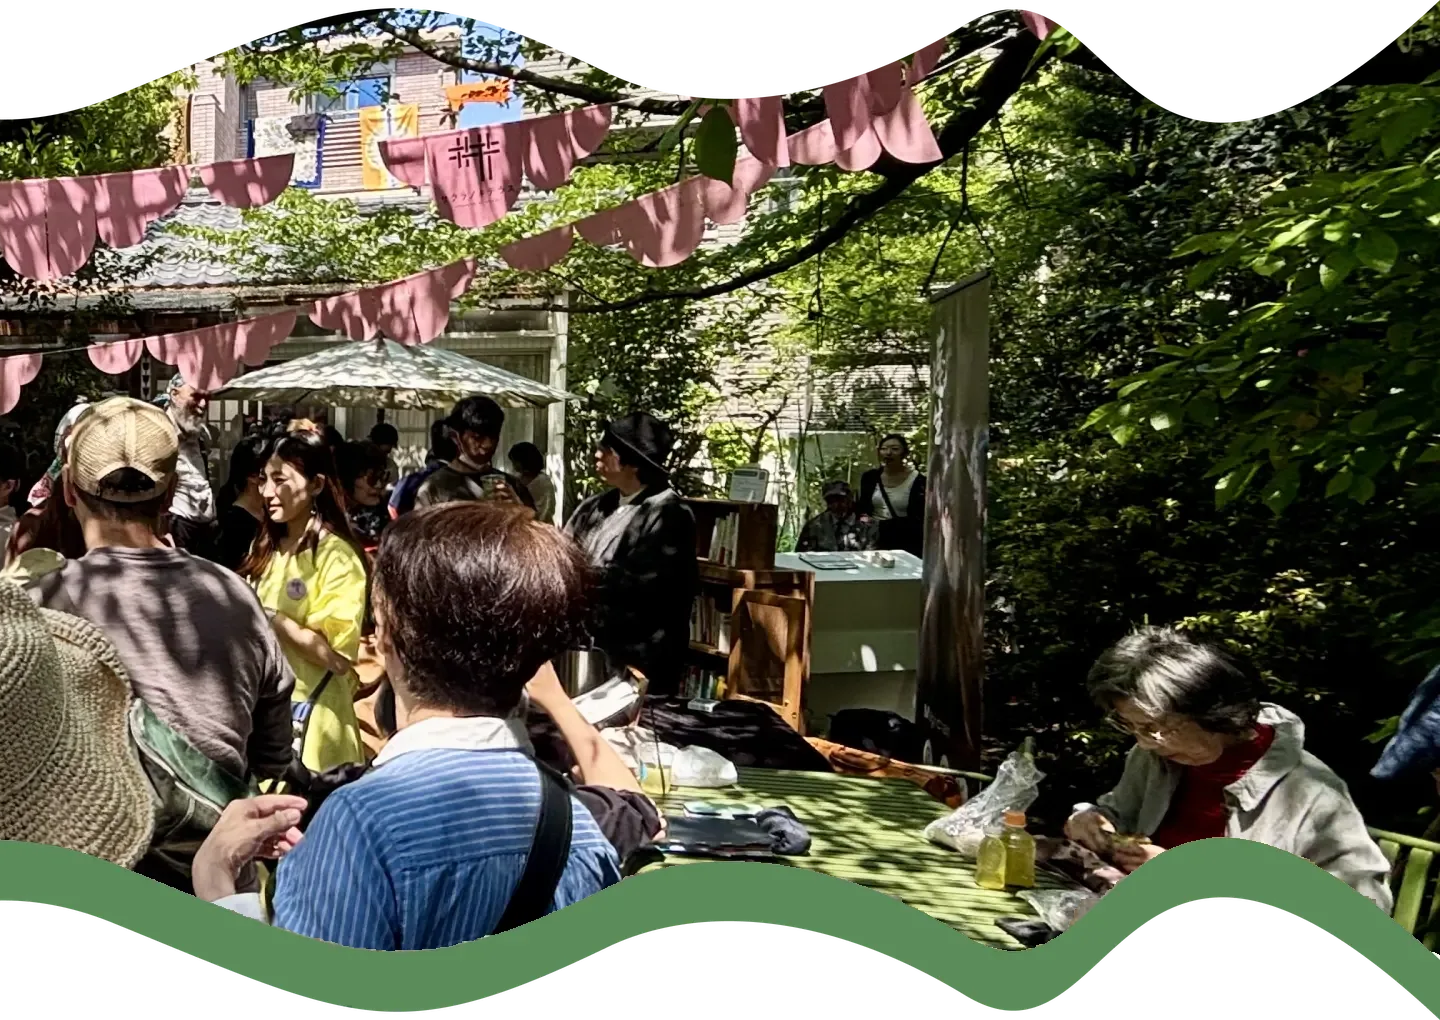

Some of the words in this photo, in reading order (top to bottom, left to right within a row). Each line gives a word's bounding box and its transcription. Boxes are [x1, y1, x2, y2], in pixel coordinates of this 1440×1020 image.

[441, 184, 514, 203] サクラノキテラス
